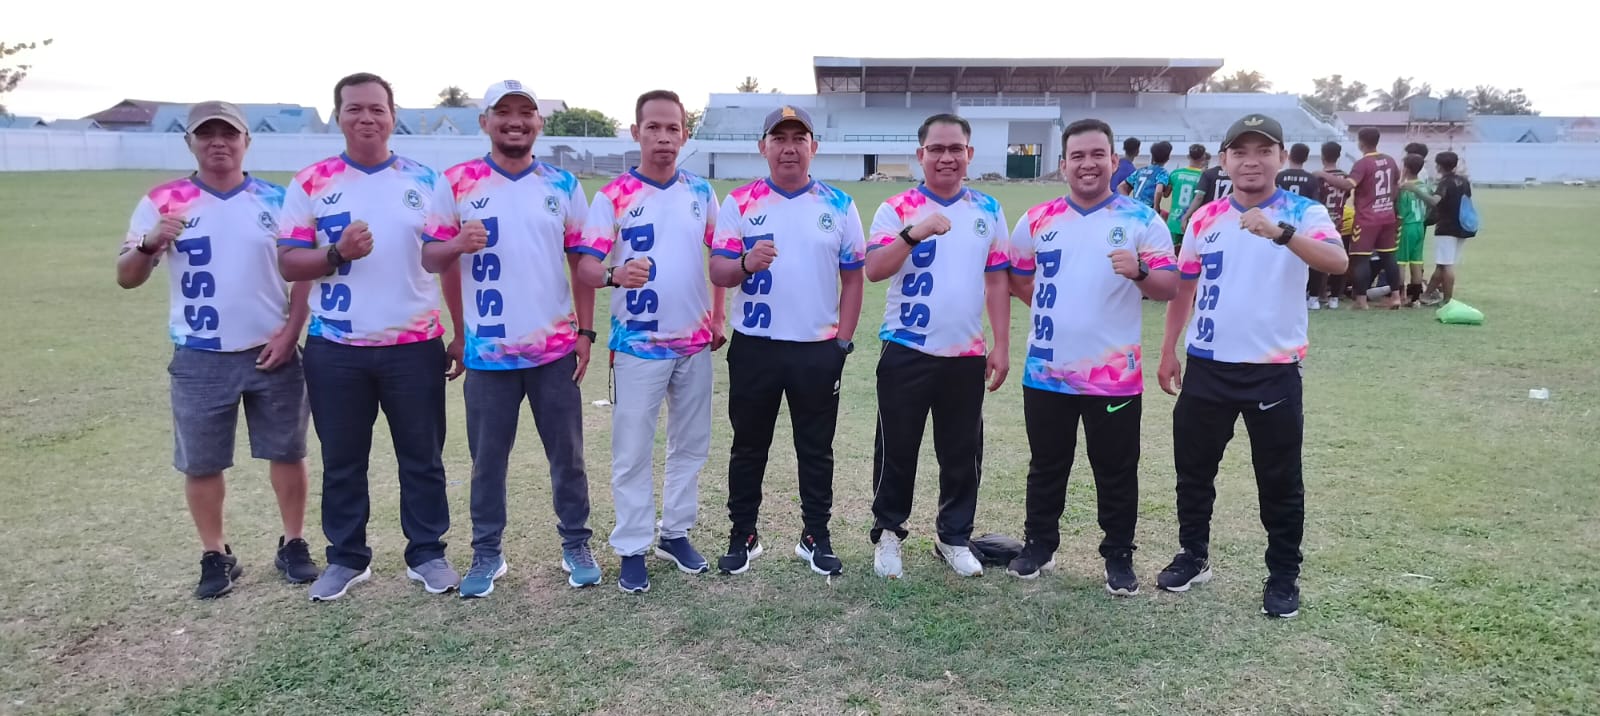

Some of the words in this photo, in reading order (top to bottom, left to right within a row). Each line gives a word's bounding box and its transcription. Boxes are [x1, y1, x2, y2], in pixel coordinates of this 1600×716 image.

[1135, 176, 1147, 198] 7
[1179, 184, 1194, 207] 8
[1214, 179, 1233, 201] 17
[1375, 168, 1391, 196] 21
[175, 235, 222, 350] PSSI
[892, 238, 936, 347] PSSI
[1029, 248, 1062, 362] PSSI
[1187, 250, 1224, 361] PSSI
